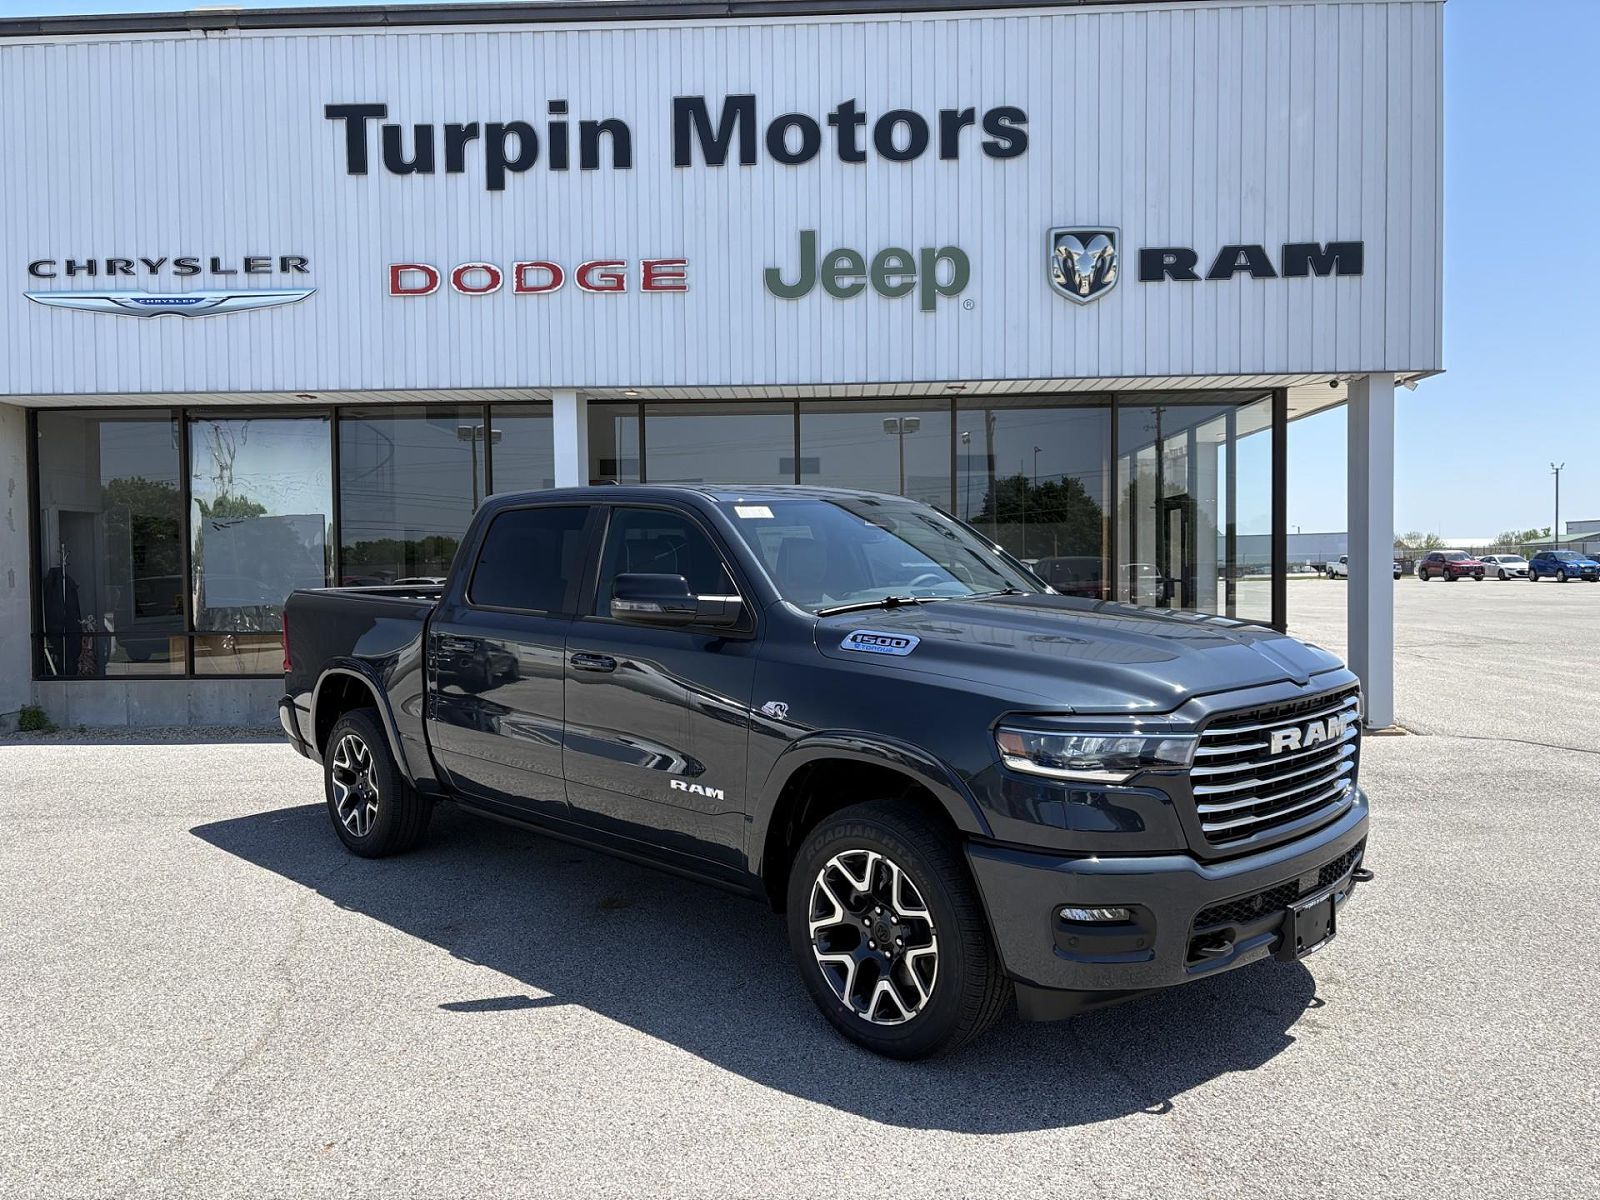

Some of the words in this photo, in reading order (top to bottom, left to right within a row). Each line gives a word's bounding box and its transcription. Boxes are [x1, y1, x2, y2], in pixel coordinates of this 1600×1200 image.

[325, 100, 632, 191] Turpin
[673, 94, 1029, 168] Motors
[27, 254, 310, 279] CHRYSLER
[389, 259, 689, 297] DODGE
[764, 229, 971, 311] Jeep
[1138, 240, 1363, 282] RAM
[853, 634, 908, 649] 1500
[1270, 714, 1350, 755] RAM
[670, 779, 725, 801] RAM
